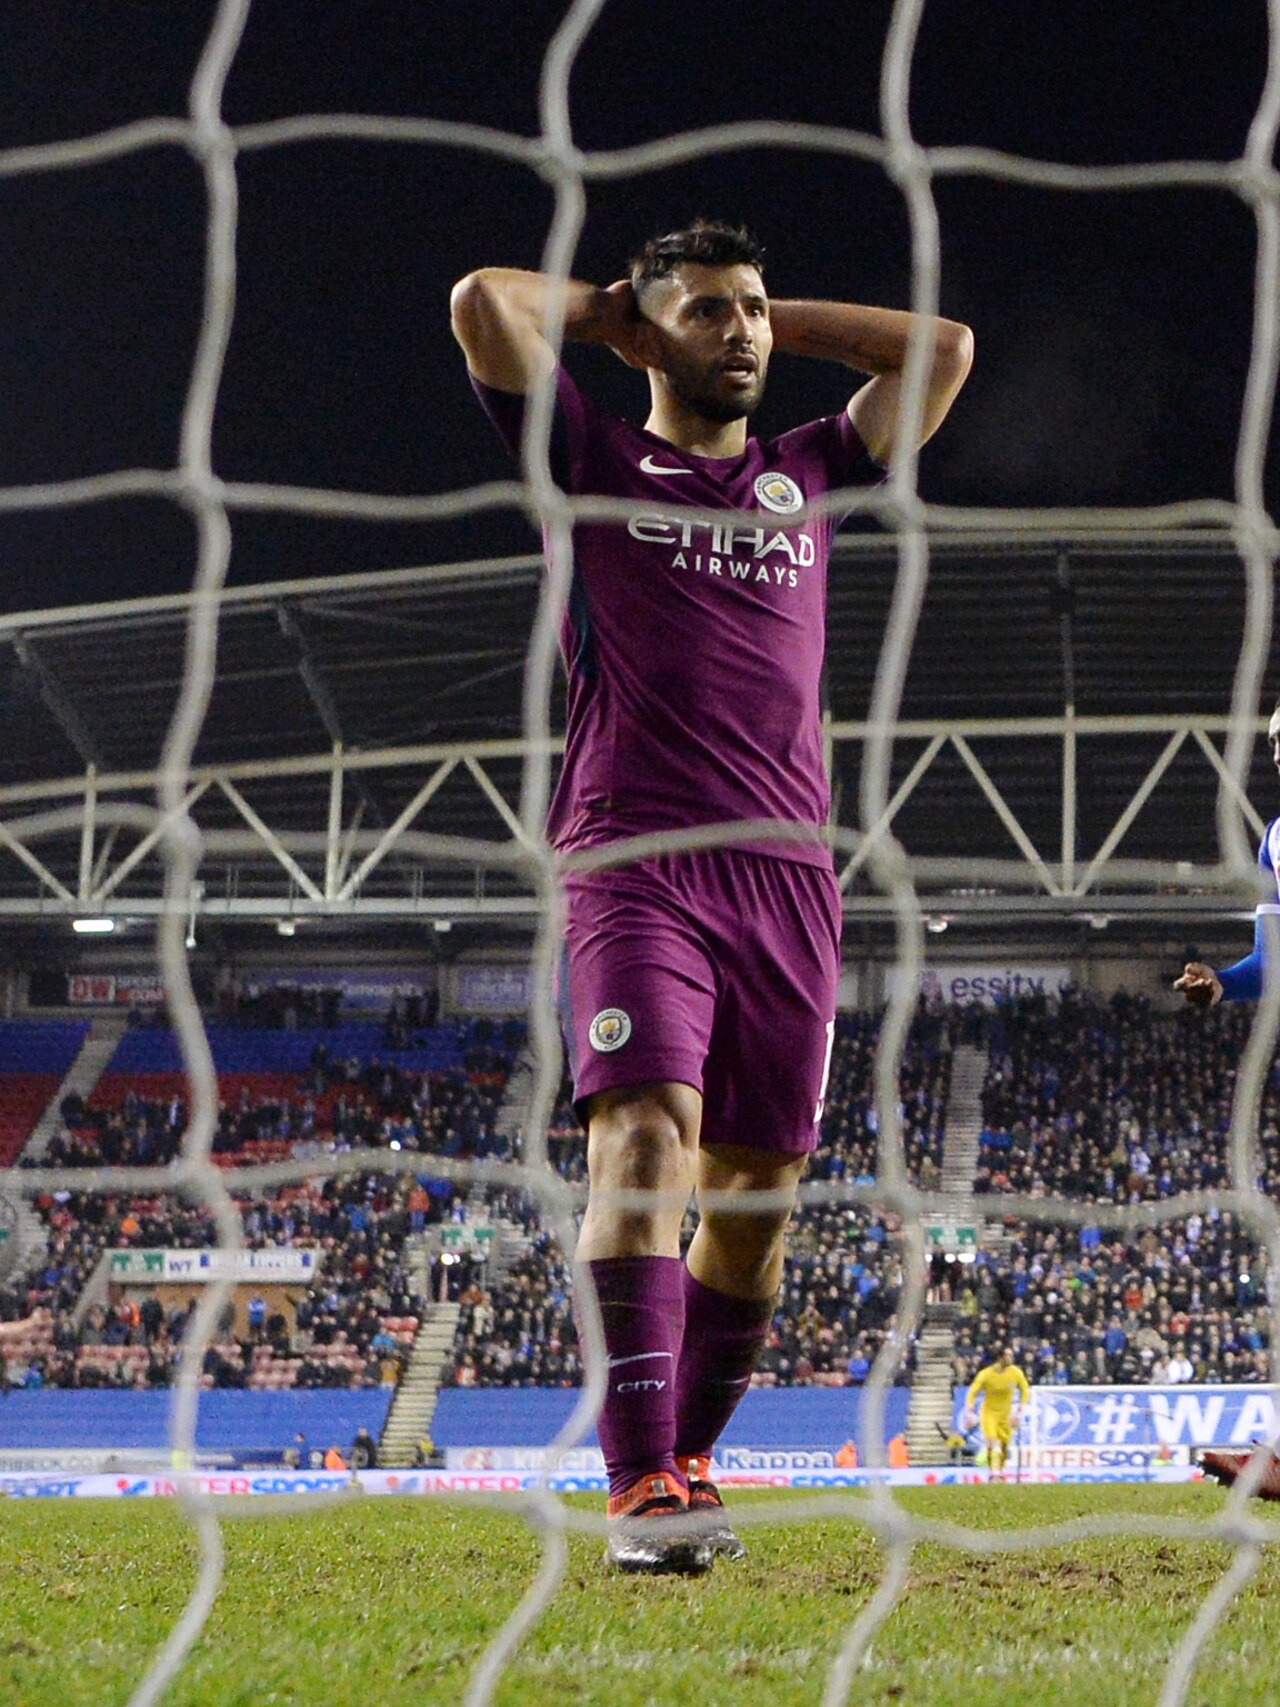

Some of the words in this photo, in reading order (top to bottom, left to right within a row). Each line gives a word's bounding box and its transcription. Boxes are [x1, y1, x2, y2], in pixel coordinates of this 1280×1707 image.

[628, 513, 815, 567] ETIHAD
[671, 552, 798, 588] AIRWAYS
[617, 1380, 666, 1393] CITY
